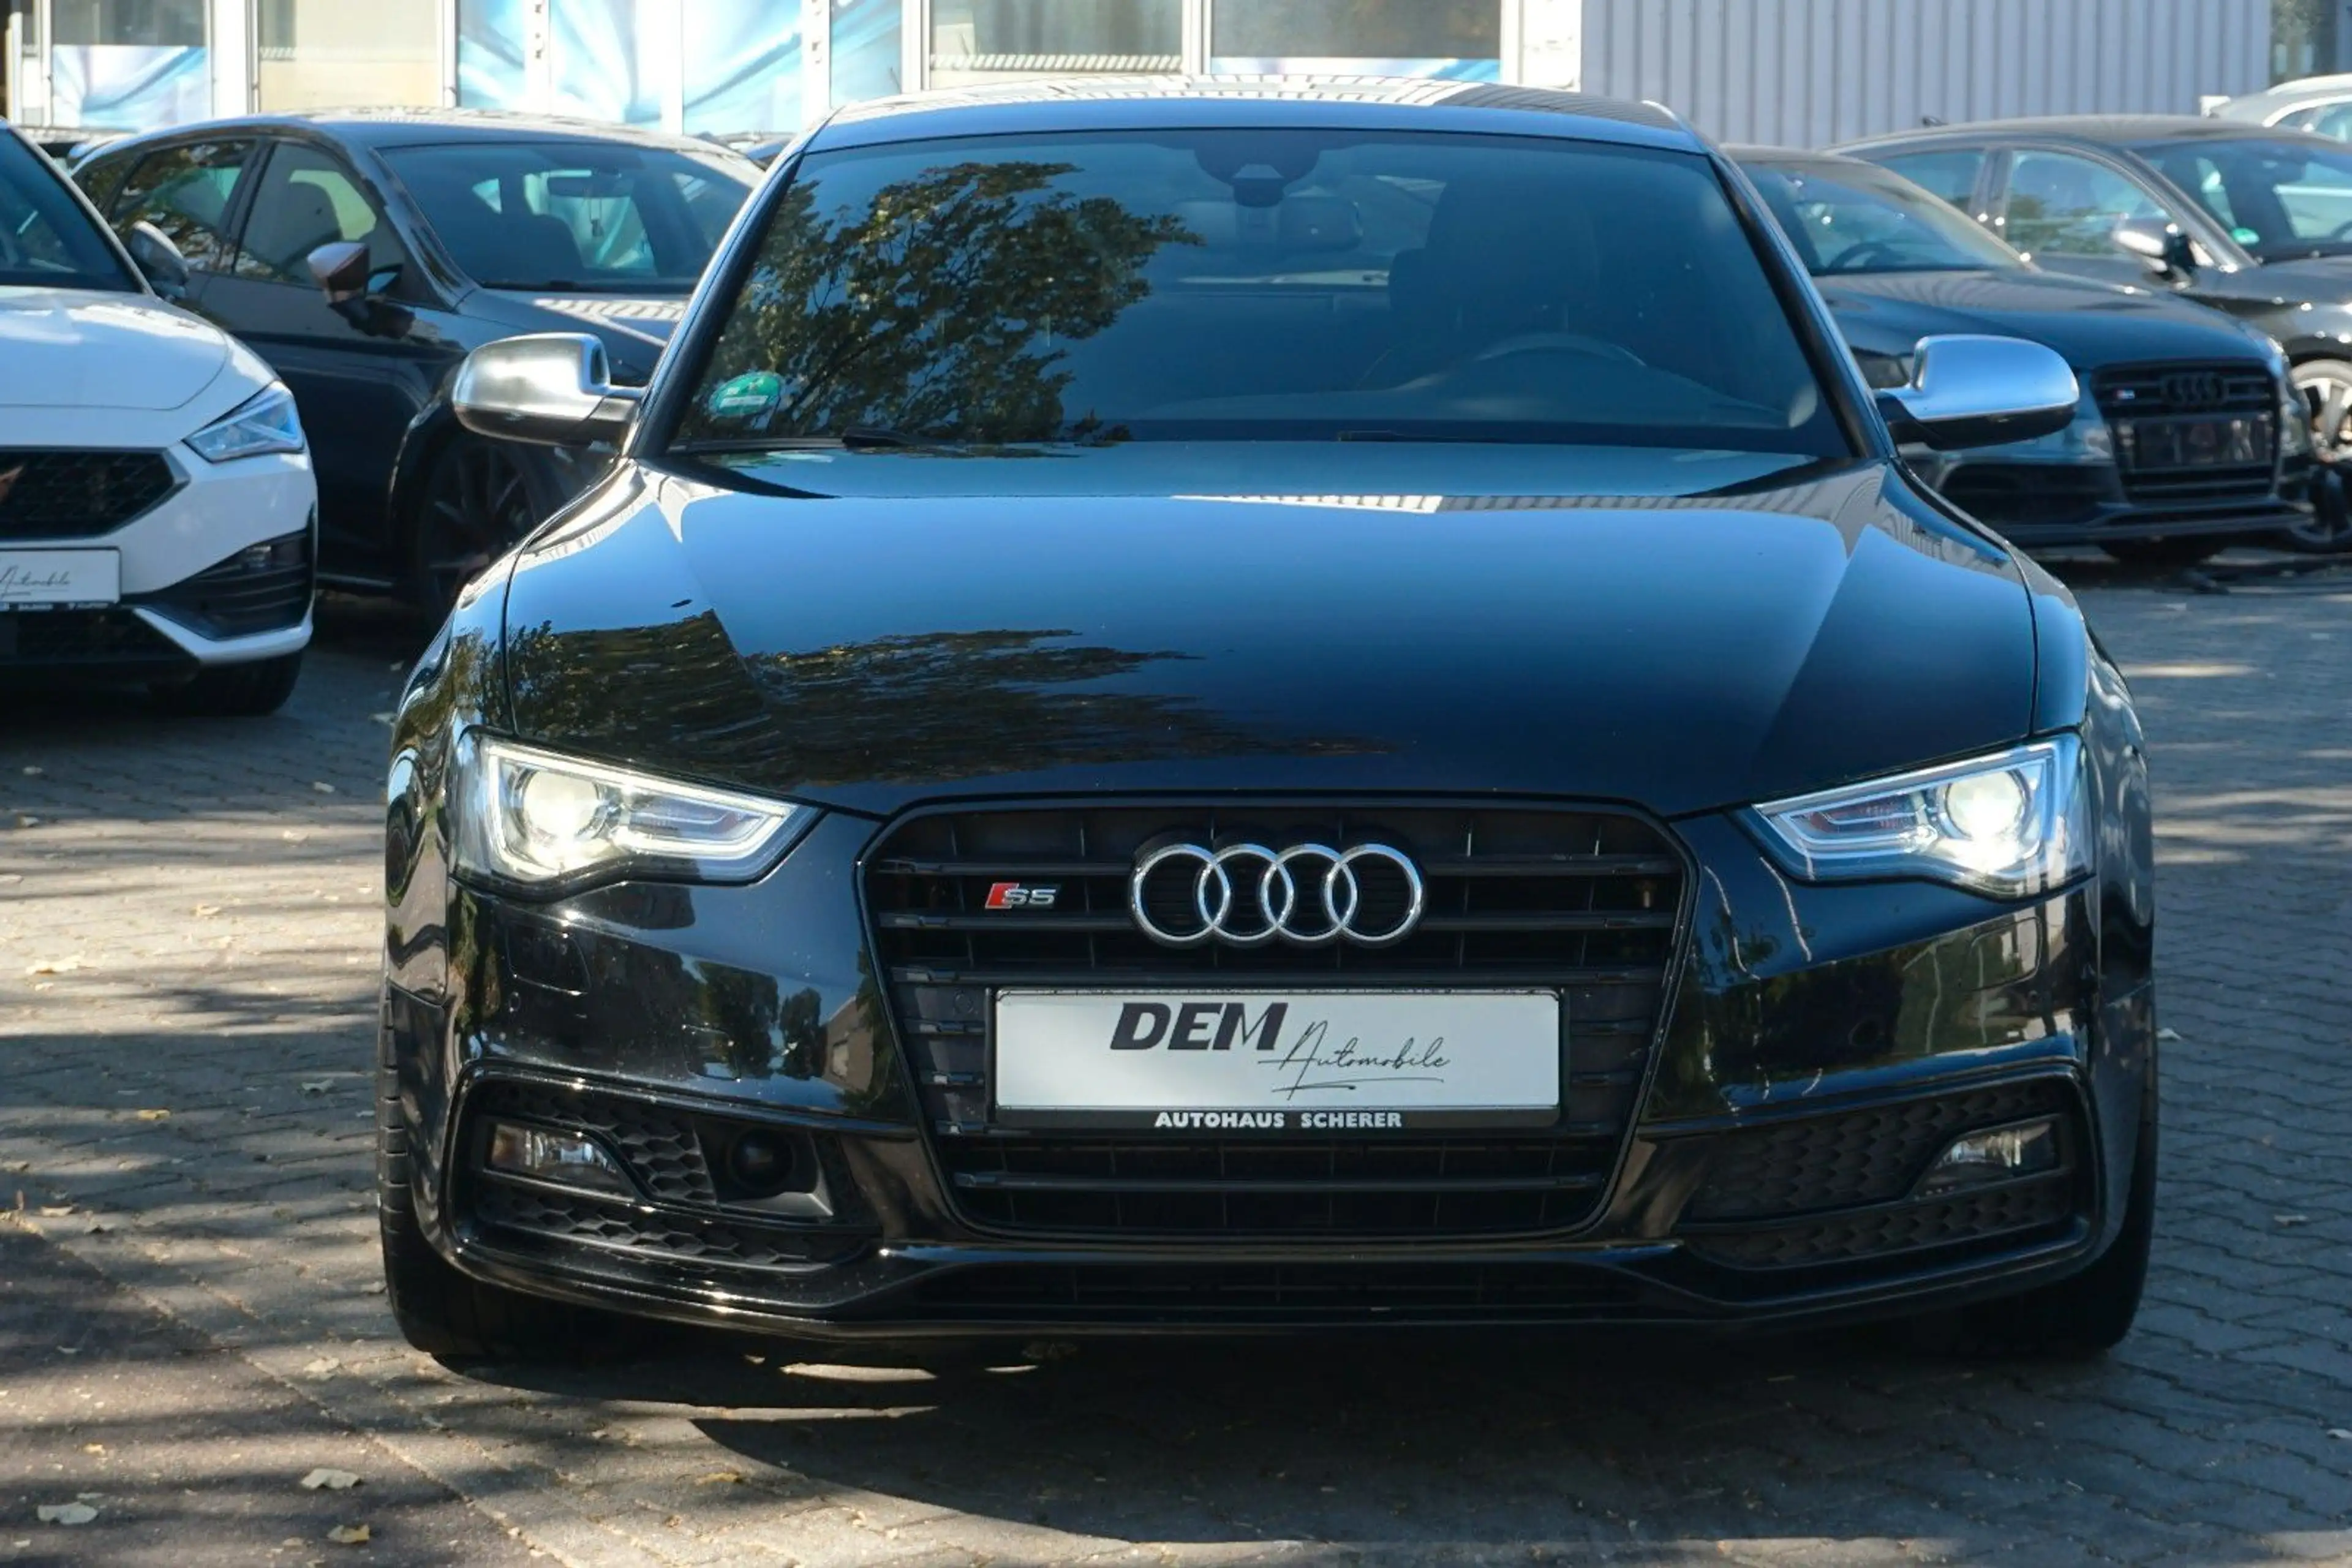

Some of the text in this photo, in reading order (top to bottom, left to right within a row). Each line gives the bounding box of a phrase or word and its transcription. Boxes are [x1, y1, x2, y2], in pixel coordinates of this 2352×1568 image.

[997, 888, 1058, 907] S5
[1110, 1003, 1450, 1101] DEM Automobile
[1155, 1112, 1401, 1128] AUTOHAUS SCHERER
